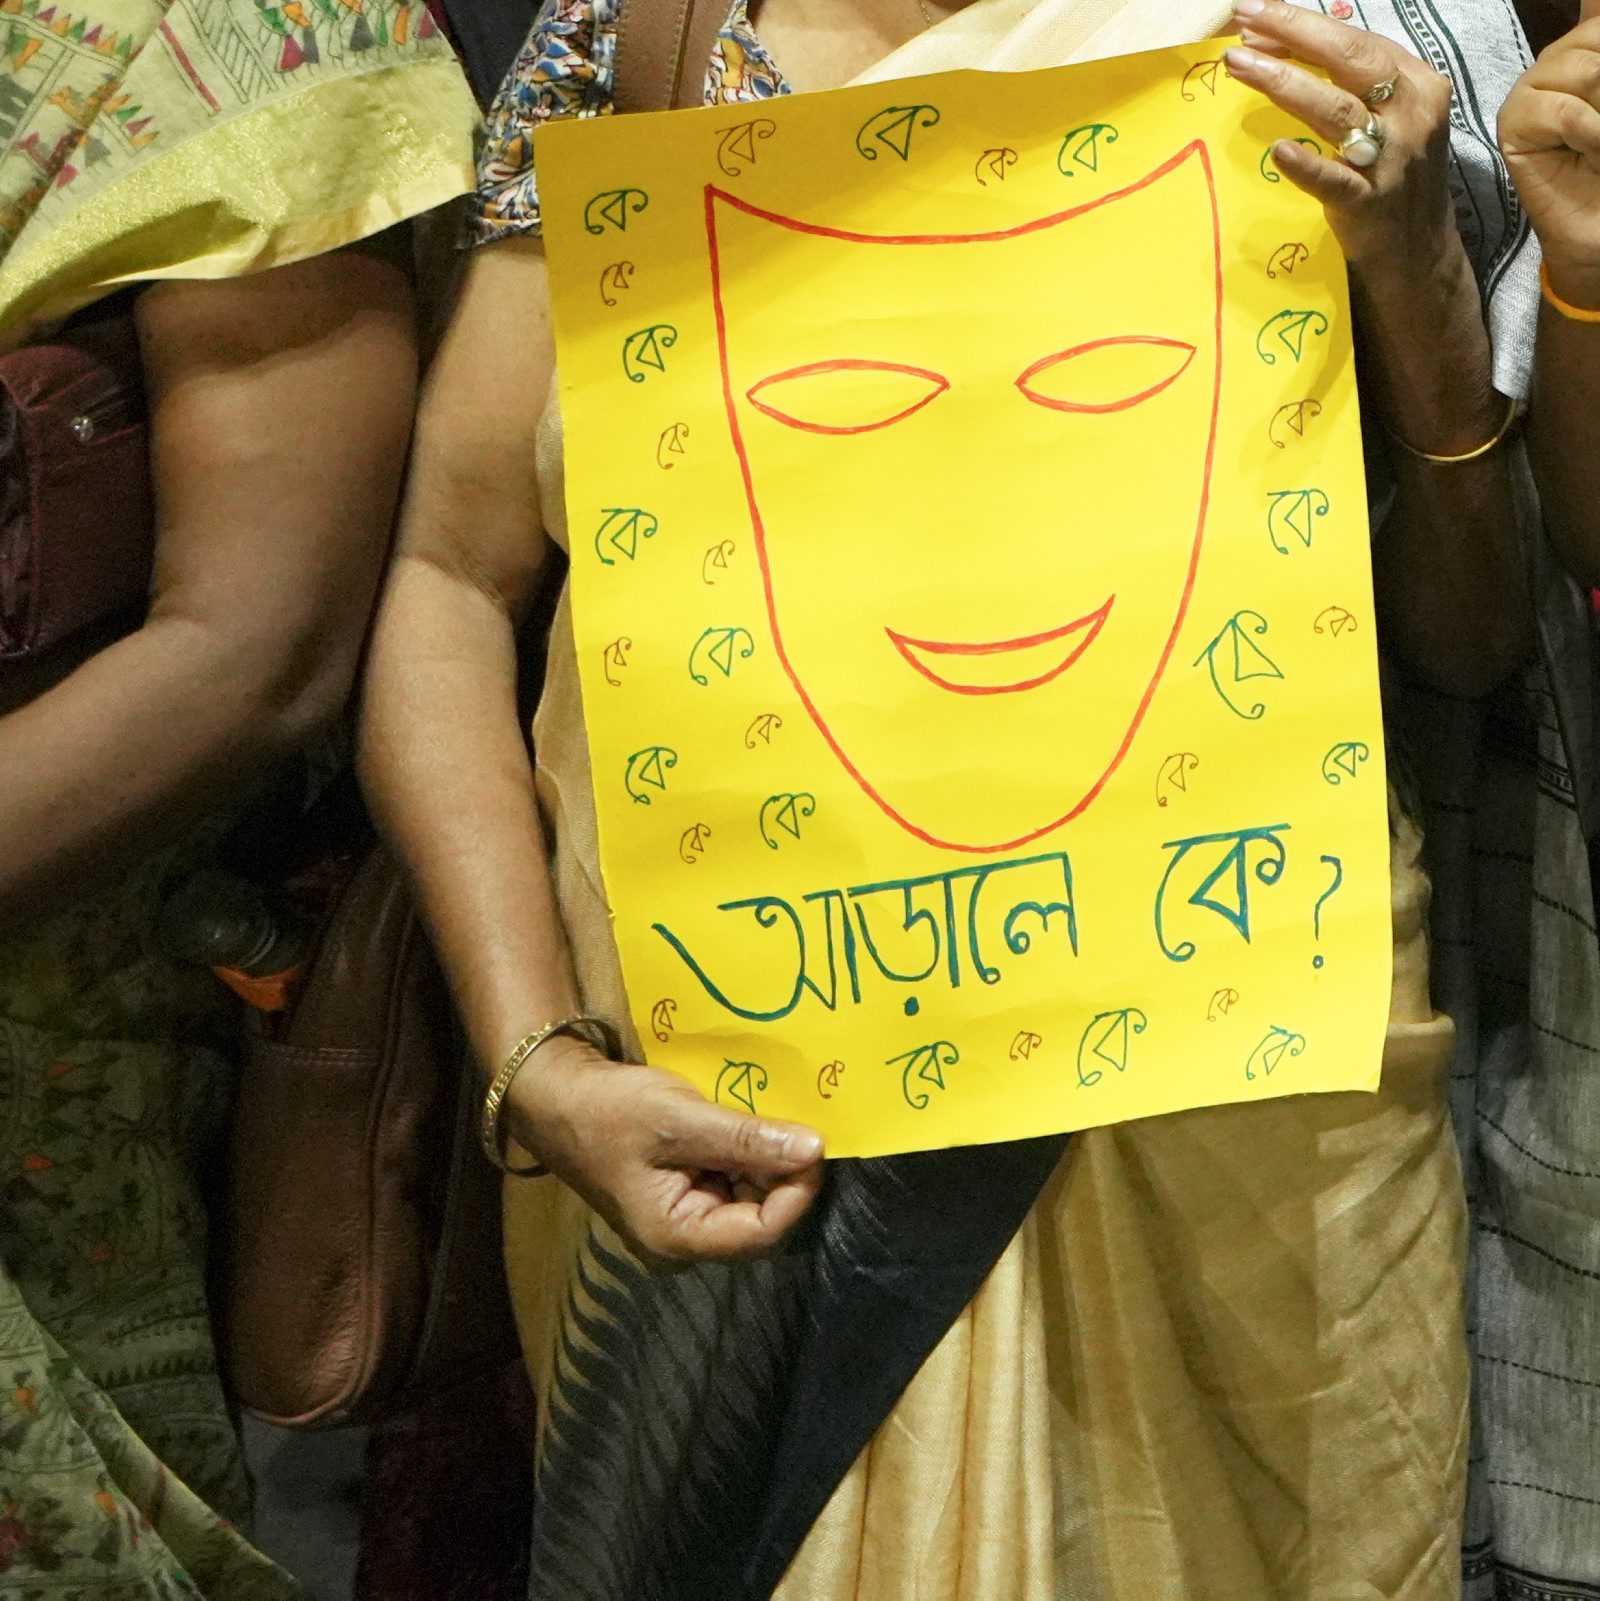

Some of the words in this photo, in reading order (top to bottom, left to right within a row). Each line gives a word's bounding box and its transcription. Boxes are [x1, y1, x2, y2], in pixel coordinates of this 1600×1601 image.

[716, 118, 777, 177] কে
[855, 104, 941, 162] কে
[1057, 123, 1119, 178] কে
[974, 147, 1019, 187] কে
[584, 188, 649, 236] কে
[599, 260, 635, 307] কে
[1265, 242, 1309, 280] কে
[622, 324, 678, 384] কে
[1256, 309, 1328, 365] কে
[656, 422, 690, 470] কে
[1269, 397, 1323, 450] কে
[594, 507, 659, 566] কে
[1266, 488, 1330, 555] কে
[703, 539, 735, 586] কে
[1313, 605, 1358, 638] কে
[603, 636, 633, 688] কে
[688, 626, 755, 687] কে
[1192, 609, 1285, 720] কে
[744, 713, 783, 750] কে
[624, 746, 678, 806] কে
[1156, 752, 1200, 808] কে
[1321, 741, 1370, 786] কে
[679, 822, 712, 865] কে
[759, 792, 816, 851] কে
[650, 850, 1080, 1019] আড়ালে
[651, 997, 678, 1044] কে
[1205, 987, 1239, 1023] কে
[1009, 1030, 1043, 1062] কে
[1076, 1007, 1148, 1087] কে
[1245, 1024, 1306, 1081] কে
[816, 1059, 846, 1100] কে
[884, 1040, 960, 1111] কে
